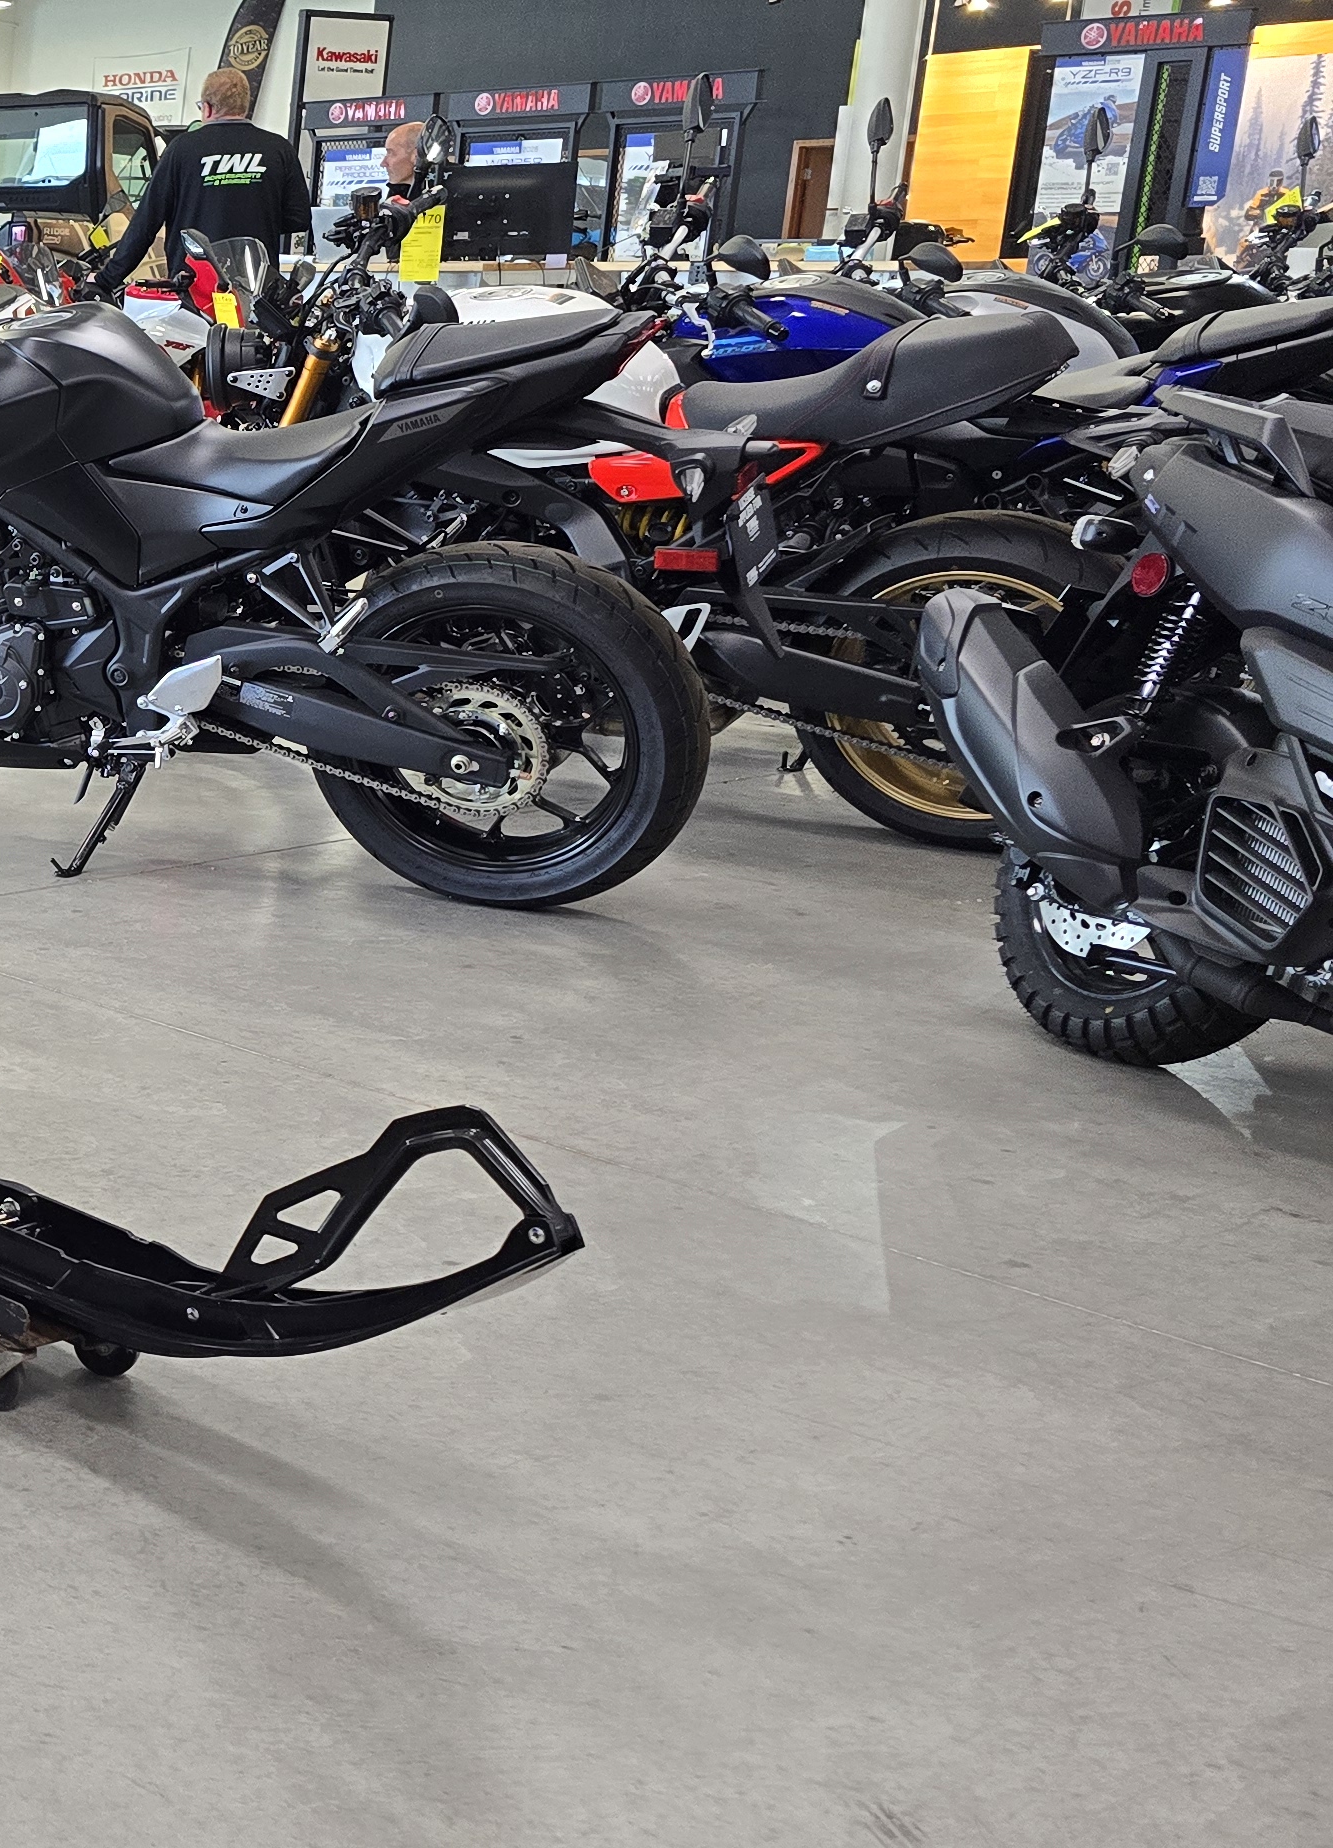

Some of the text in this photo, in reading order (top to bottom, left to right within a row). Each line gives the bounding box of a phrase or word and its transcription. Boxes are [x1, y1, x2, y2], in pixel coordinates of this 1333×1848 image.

[1109, 17, 1204, 47] YAMAHA
[228, 39, 269, 58] 10 YEAR
[316, 46, 379, 64] Kawasaki
[102, 69, 179, 88] HONDA
[1069, 67, 1132, 80] YZF-R9
[118, 88, 177, 103] ARINE
[653, 78, 724, 104] YAMA
[494, 89, 560, 114] YAMAHA
[346, 100, 406, 122] YAMAHA
[1208, 72, 1232, 153] SUPERSPORT
[345, 153, 371, 161] YAMAHA
[493, 146, 520, 154] YAMAHA
[200, 153, 267, 177] TWL
[335, 164, 385, 173] PERFORMA
[341, 171, 387, 179] PRODUCTS
[43, 227, 71, 236] RIDGE
[712, 342, 767, 356] MT-07
[396, 413, 442, 434] YAMAHA
